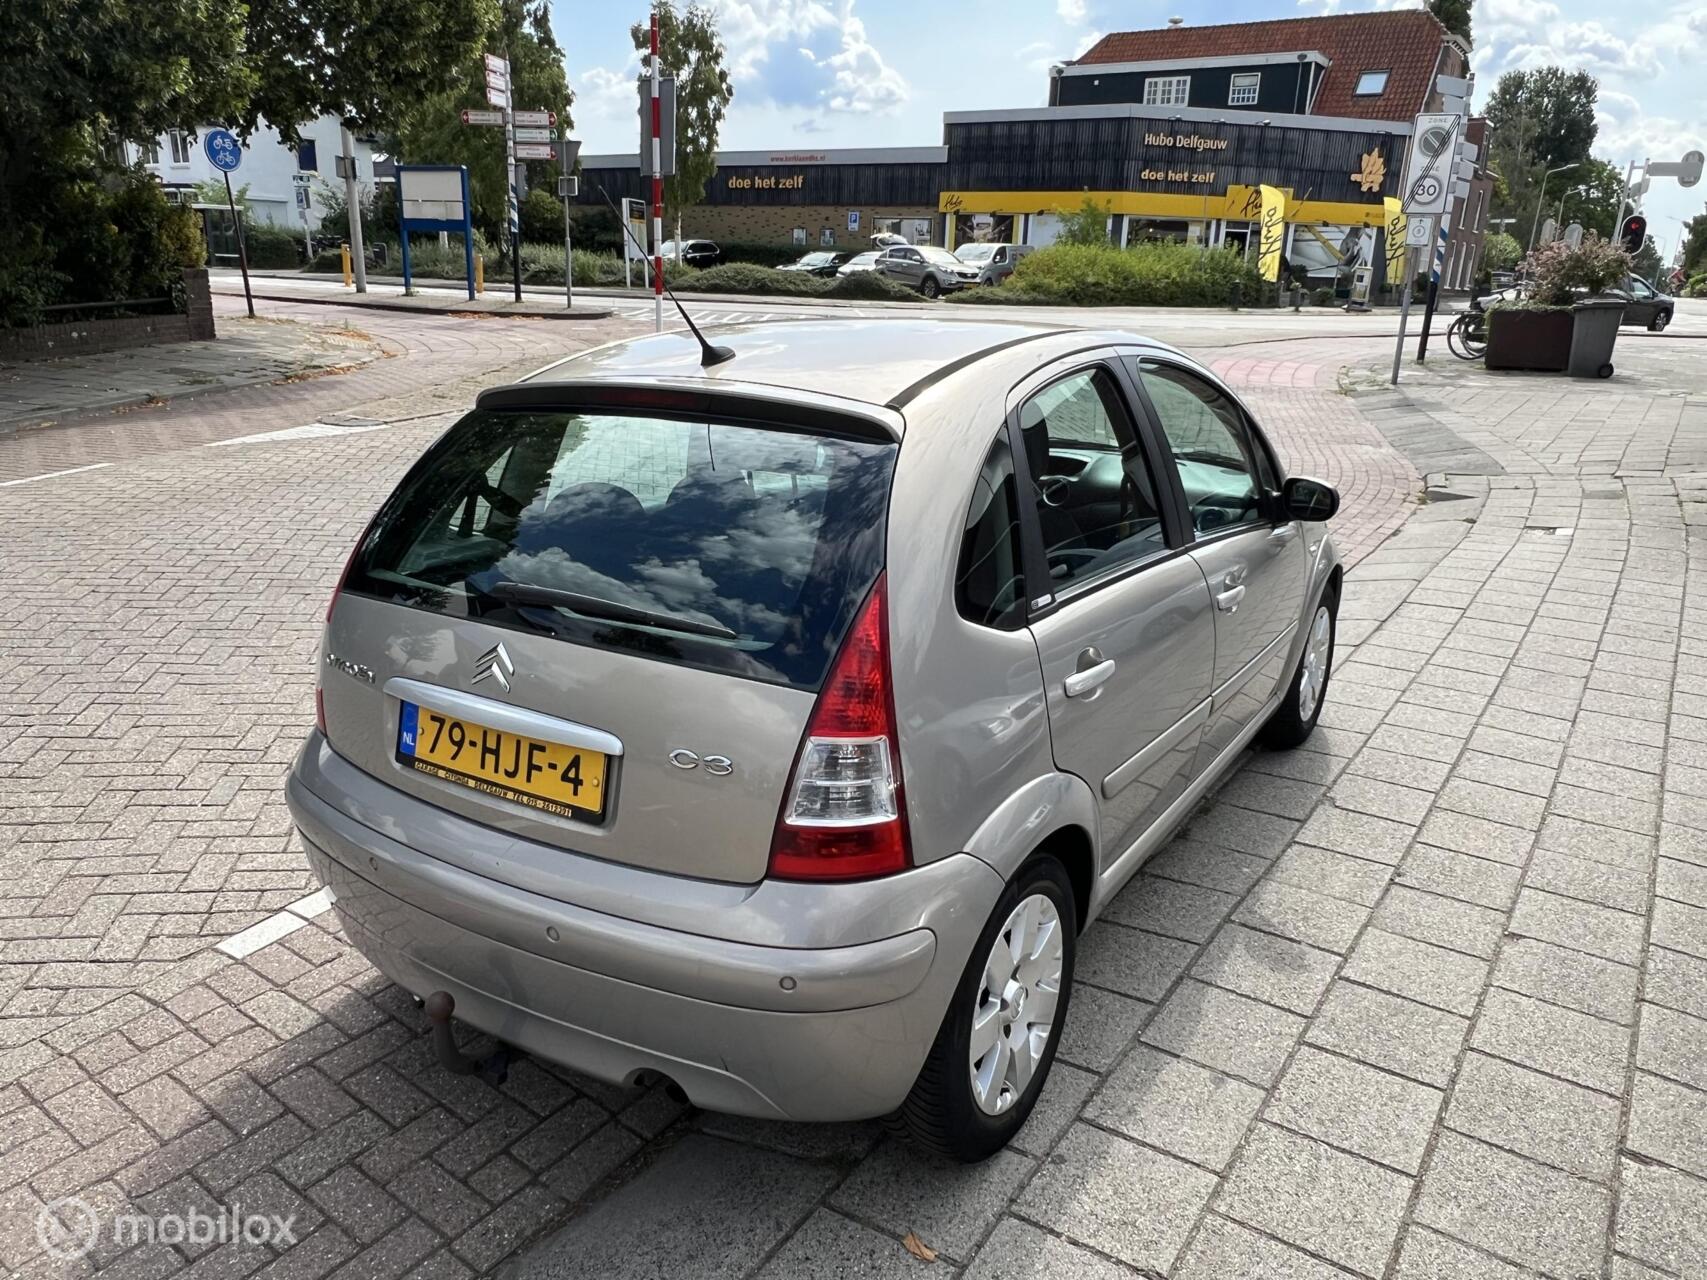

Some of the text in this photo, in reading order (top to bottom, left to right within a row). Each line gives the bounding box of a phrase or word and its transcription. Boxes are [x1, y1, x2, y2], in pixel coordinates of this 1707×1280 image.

[1144, 132, 1228, 151] Hubo Delfgauw
[728, 176, 804, 189] doe het zelf
[1141, 168, 1215, 184] doe het zelf
[1416, 184, 1437, 197] 30
[943, 194, 963, 211] Hubo
[402, 731, 416, 747] NL
[428, 714, 585, 798] 79-HJF-4
[668, 748, 733, 776] C3
